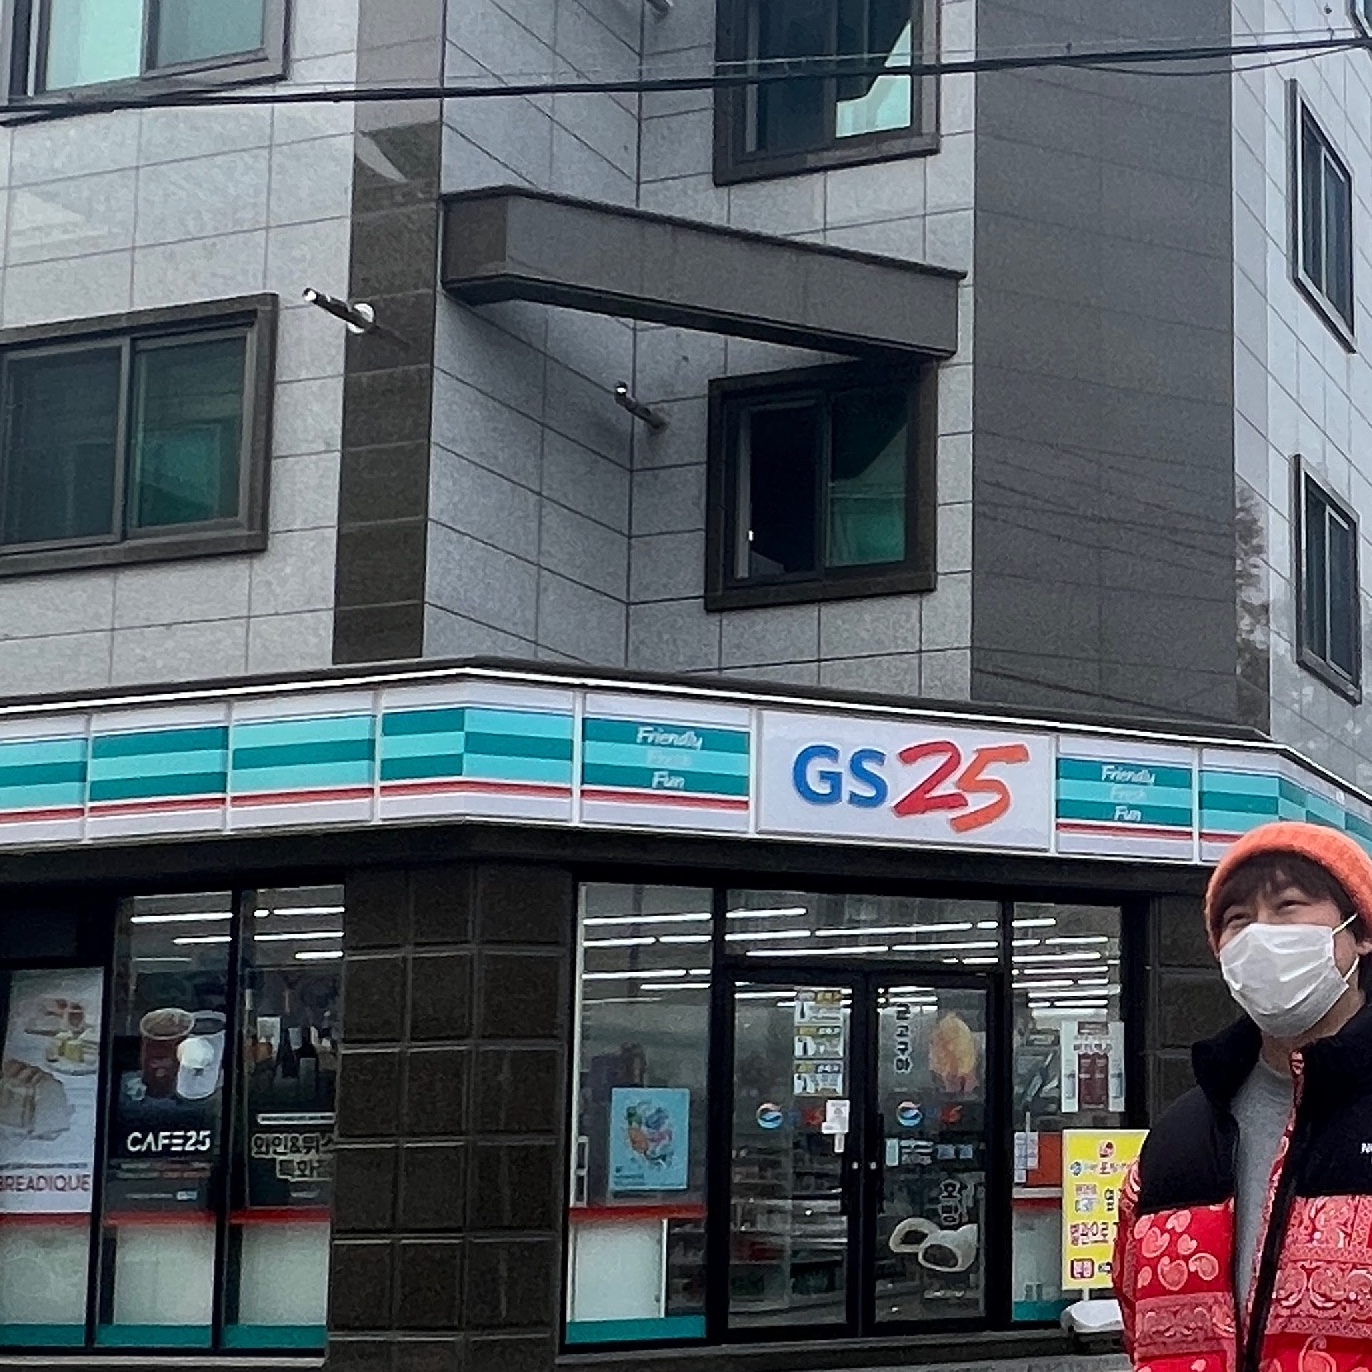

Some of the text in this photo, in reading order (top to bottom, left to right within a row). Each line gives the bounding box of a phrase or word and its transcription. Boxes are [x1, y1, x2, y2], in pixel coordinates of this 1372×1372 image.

[636, 727, 703, 750] Friendly
[652, 771, 685, 789] Fun
[1101, 765, 1156, 786] Friendly
[792, 740, 1030, 833] GS25
[1113, 805, 1142, 821] Fun
[127, 1129, 211, 1151] CAFE25
